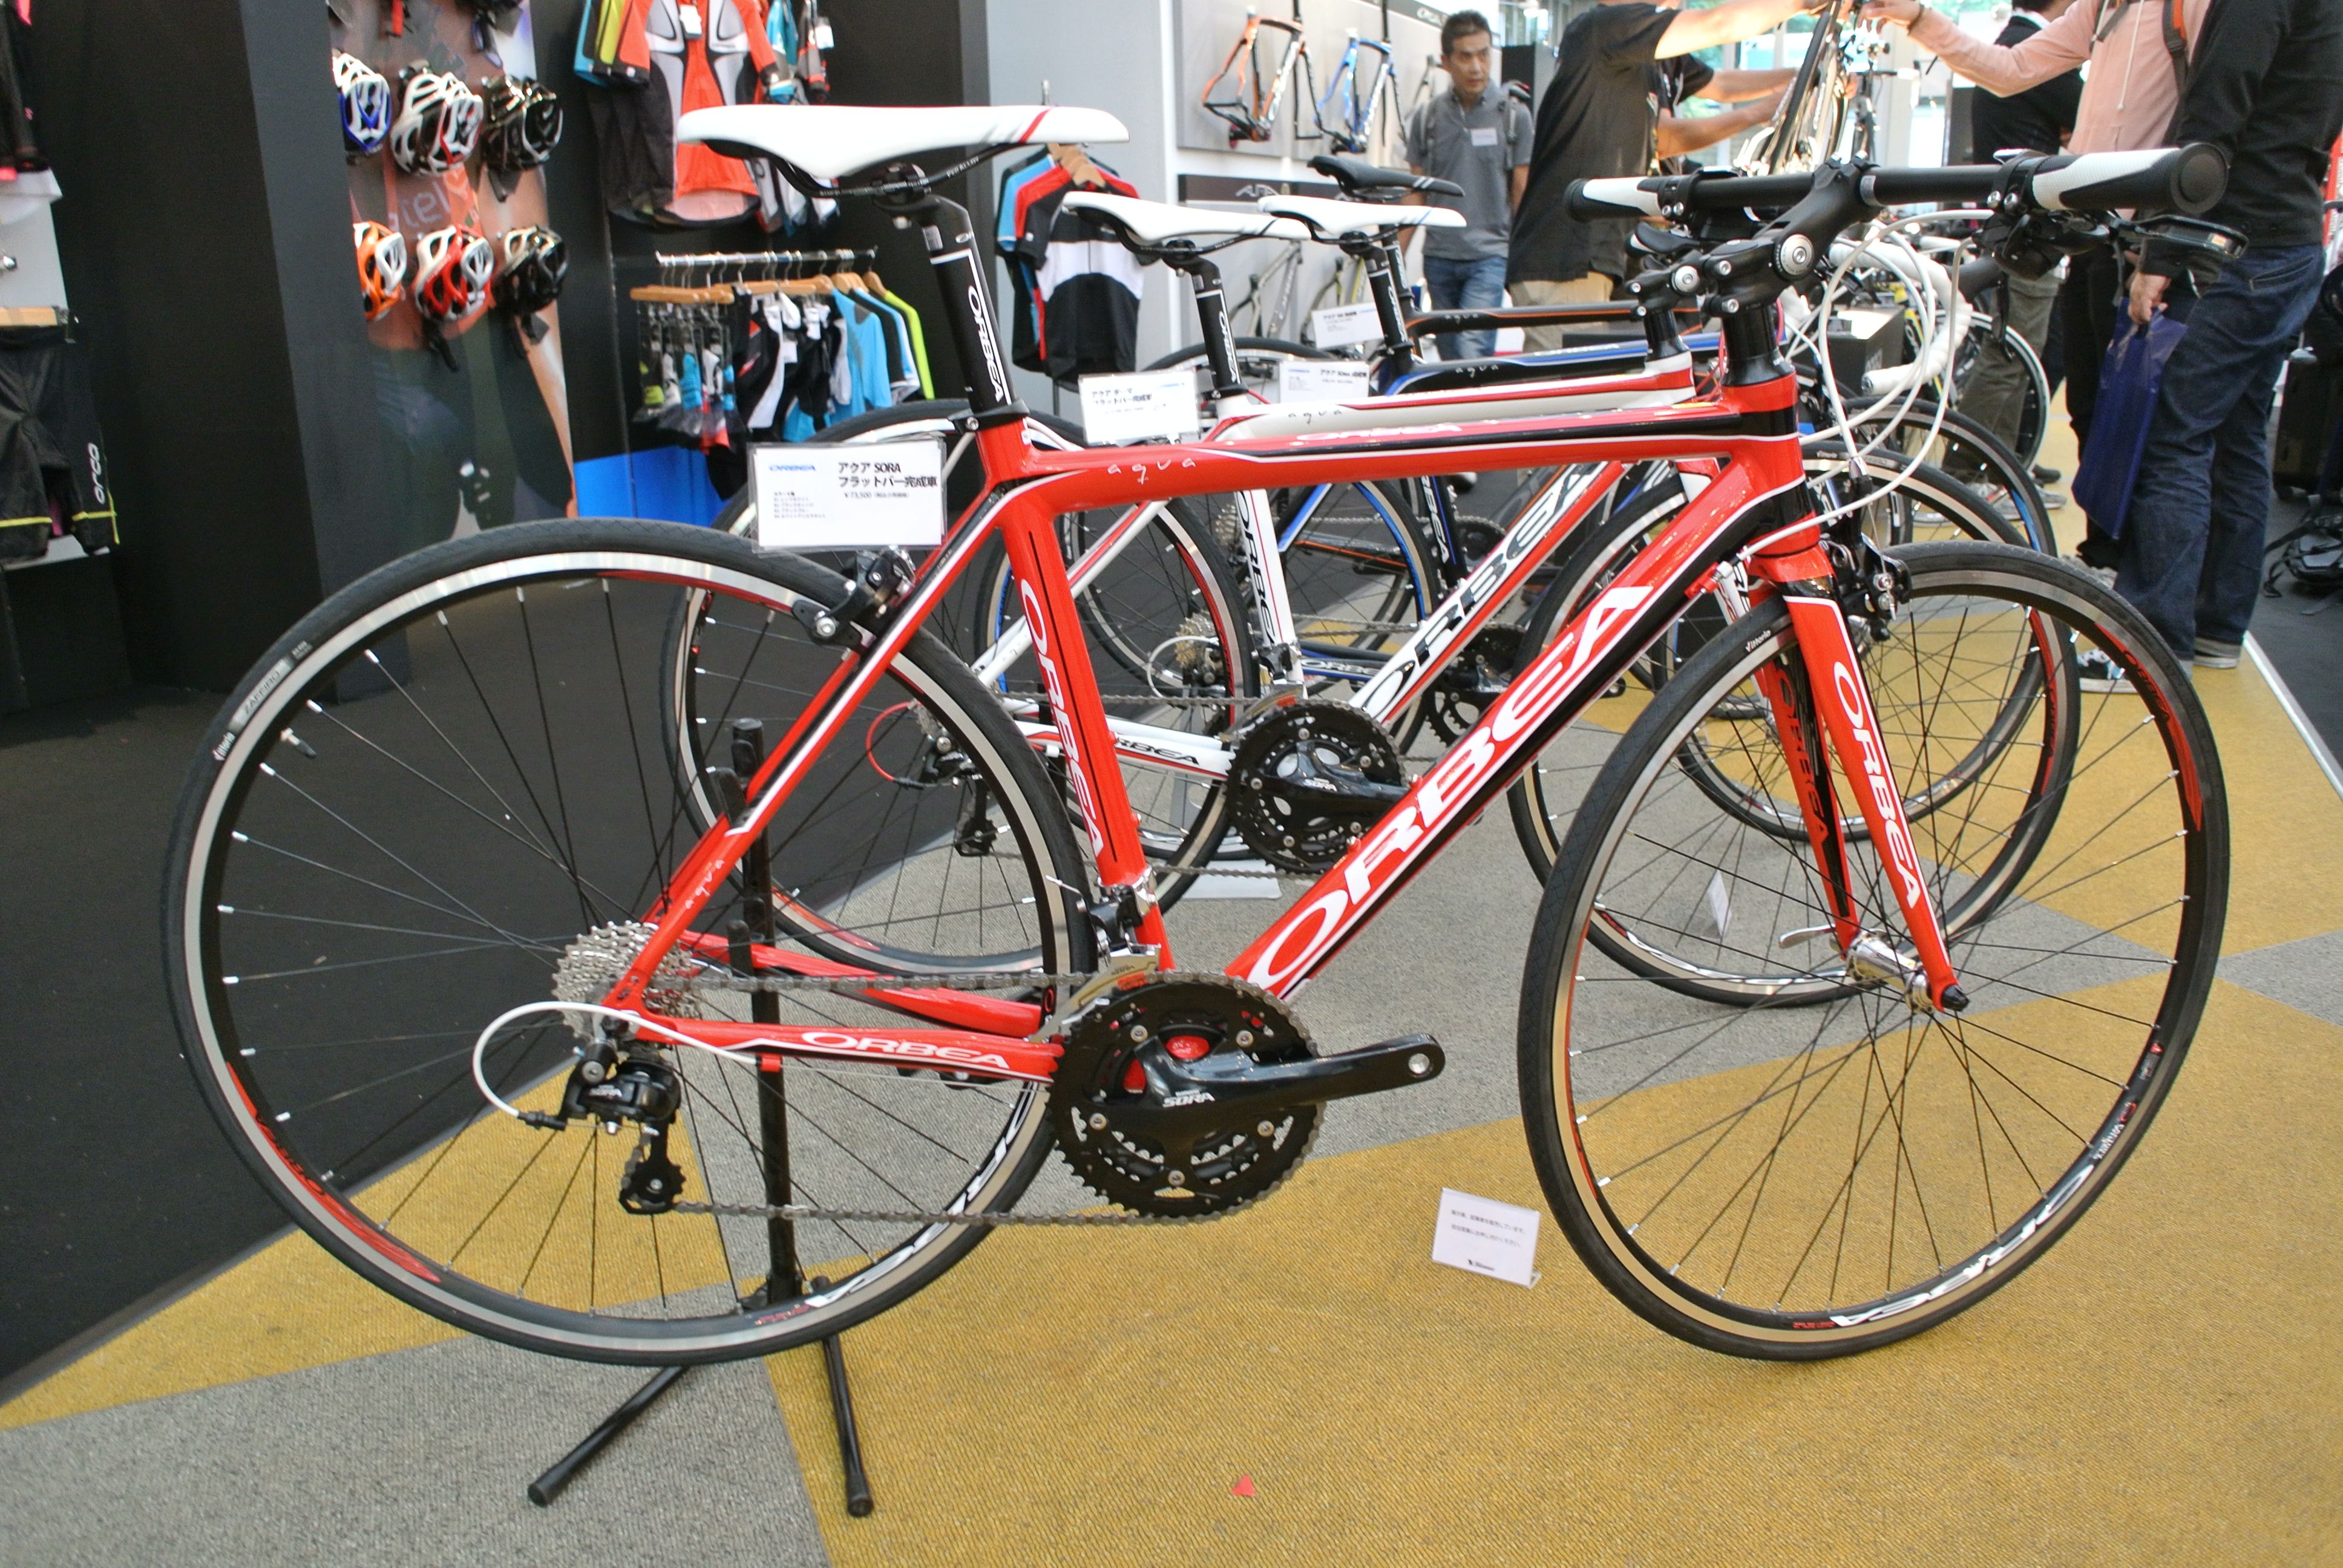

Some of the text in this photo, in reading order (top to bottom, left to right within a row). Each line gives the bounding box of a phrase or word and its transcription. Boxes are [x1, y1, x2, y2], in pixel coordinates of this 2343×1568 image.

[968, 286, 1004, 403] ORBEA
[1288, 409, 1343, 425] aqua
[839, 462, 902, 474] アクア SORA
[839, 476, 938, 488] フラットバー完成車
[1107, 458, 1196, 485] aqua
[1021, 579, 1104, 858] ORBEA
[1248, 586, 1654, 987] ORBEA
[1833, 661, 1921, 909] ORBEA
[801, 1031, 1010, 1070] ORBEA
[1162, 1092, 1216, 1108] SORA
